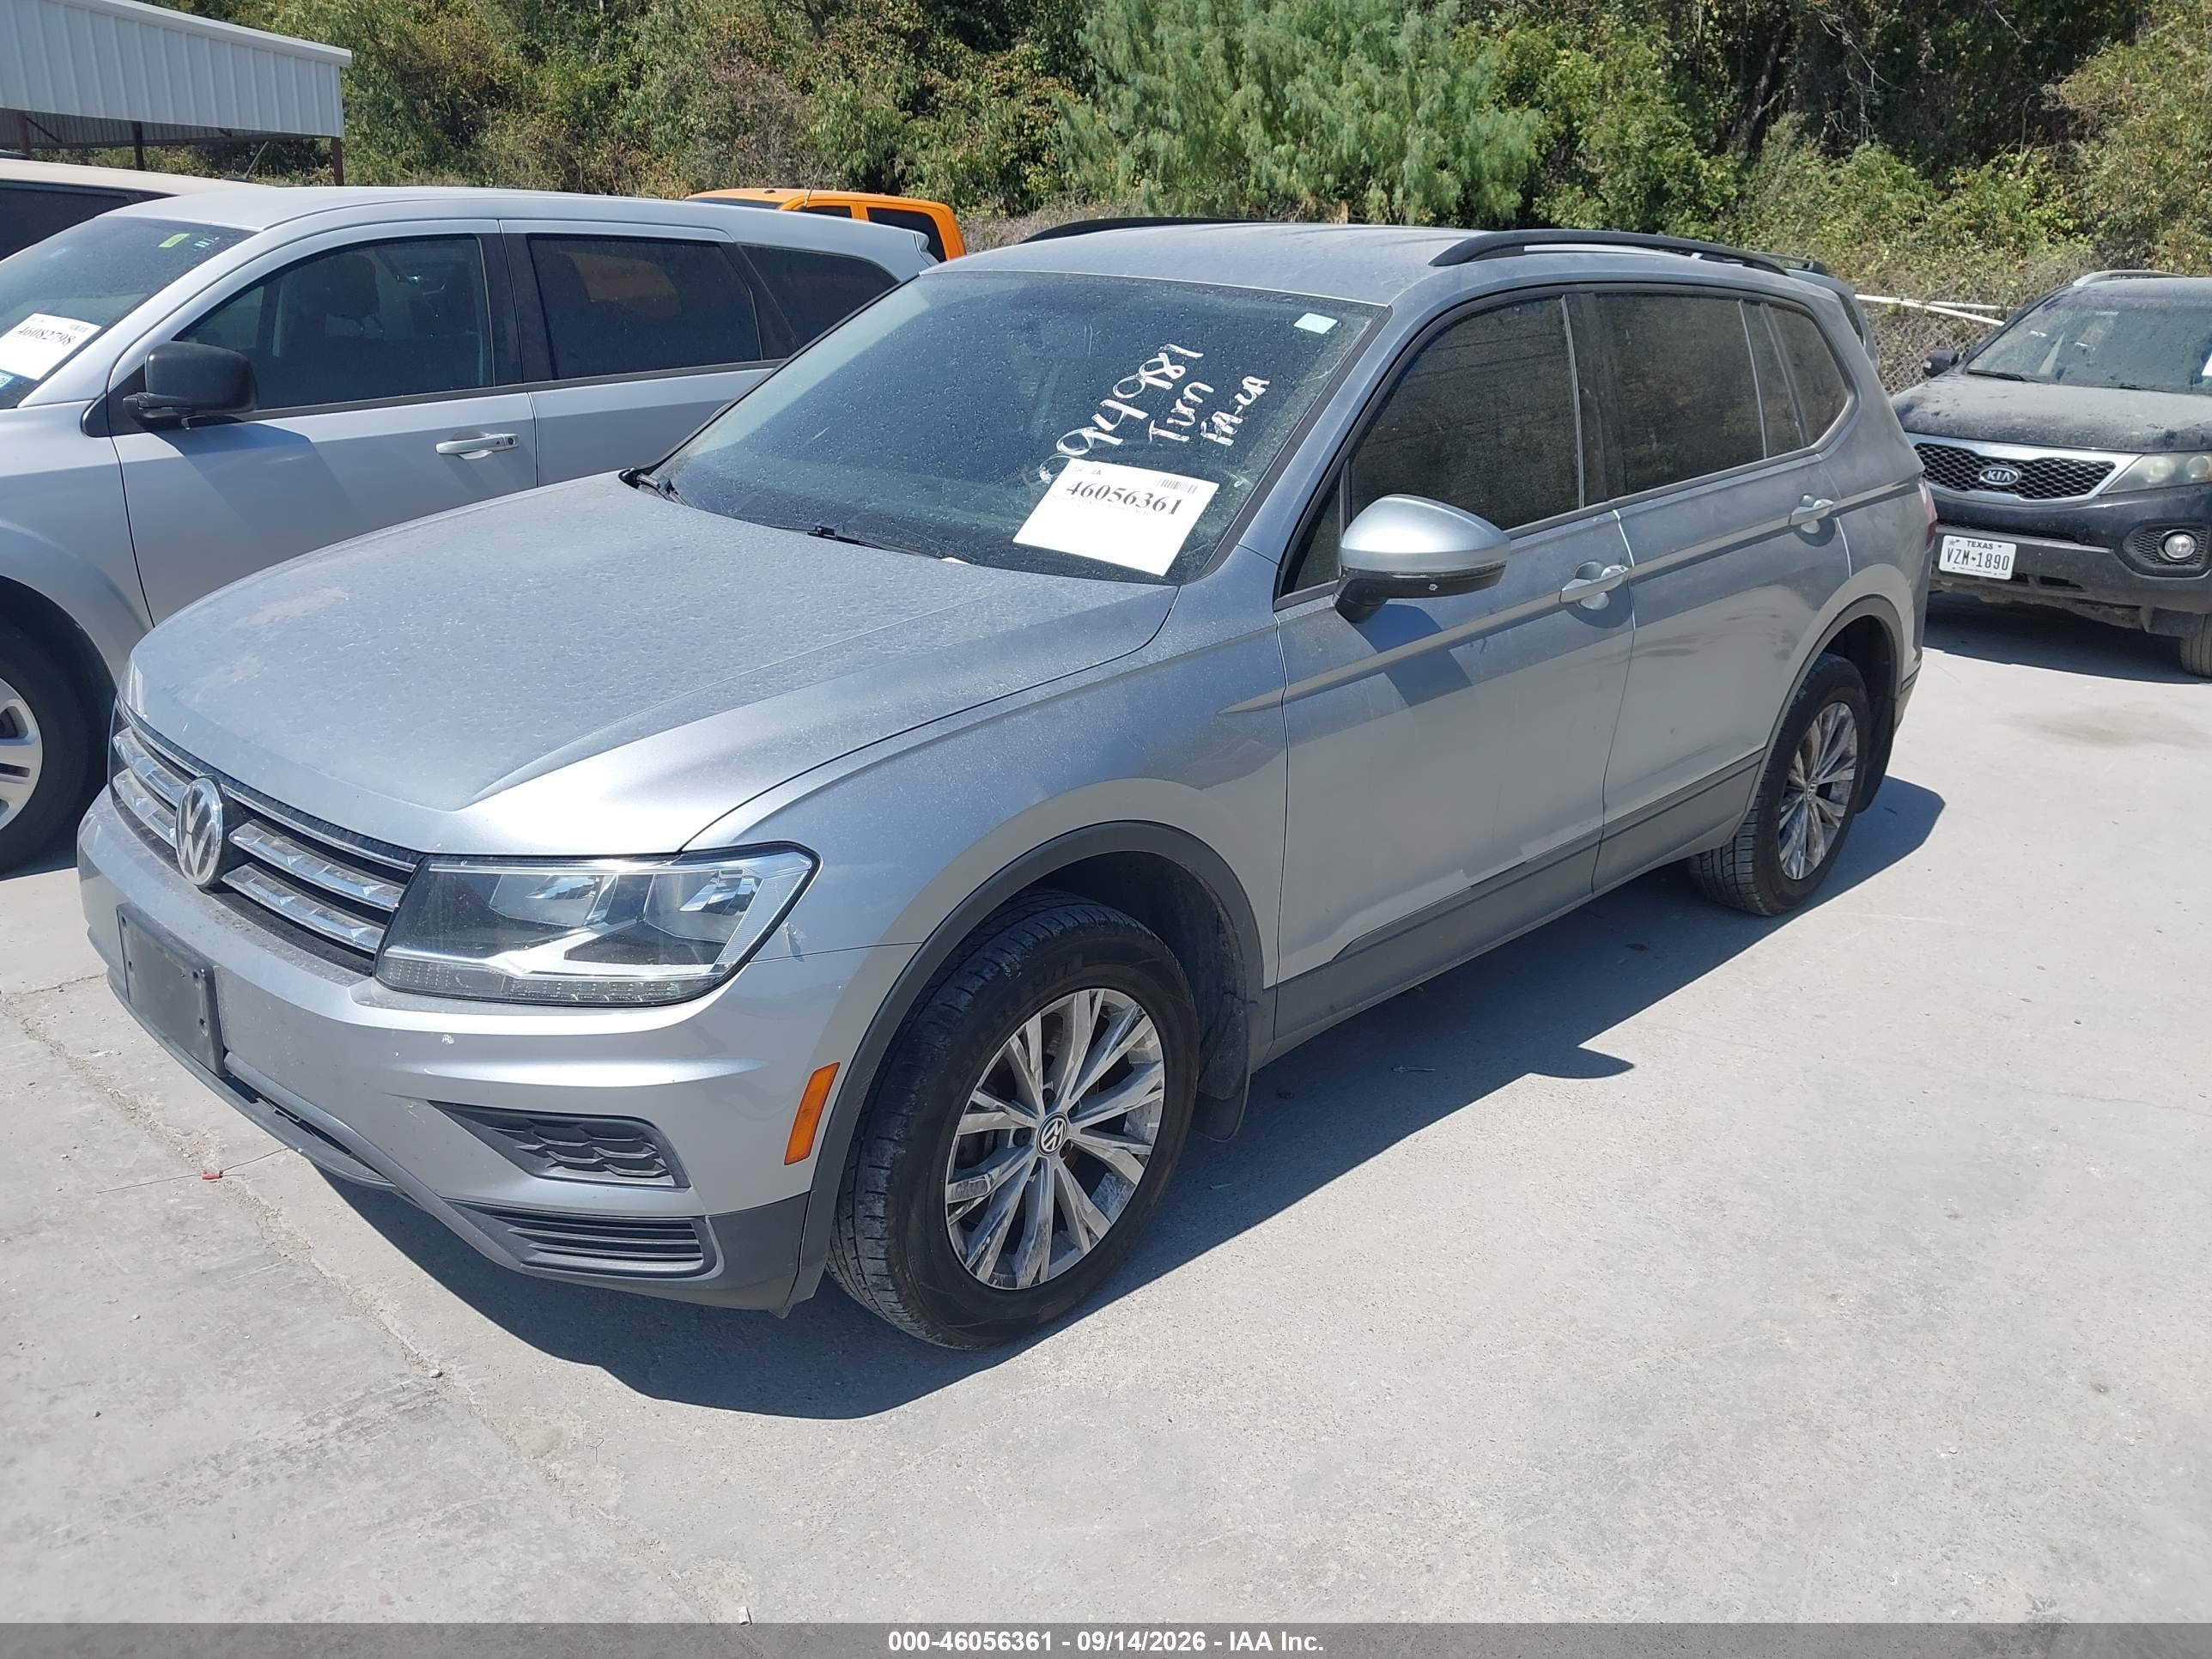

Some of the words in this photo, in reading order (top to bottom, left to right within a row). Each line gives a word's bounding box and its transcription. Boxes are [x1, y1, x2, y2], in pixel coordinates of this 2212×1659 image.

[17, 325, 76, 346] 46082798
[1987, 469, 2010, 482] KIA
[1066, 480, 1182, 516] 46056361
[1966, 539, 1994, 550] TEXAS
